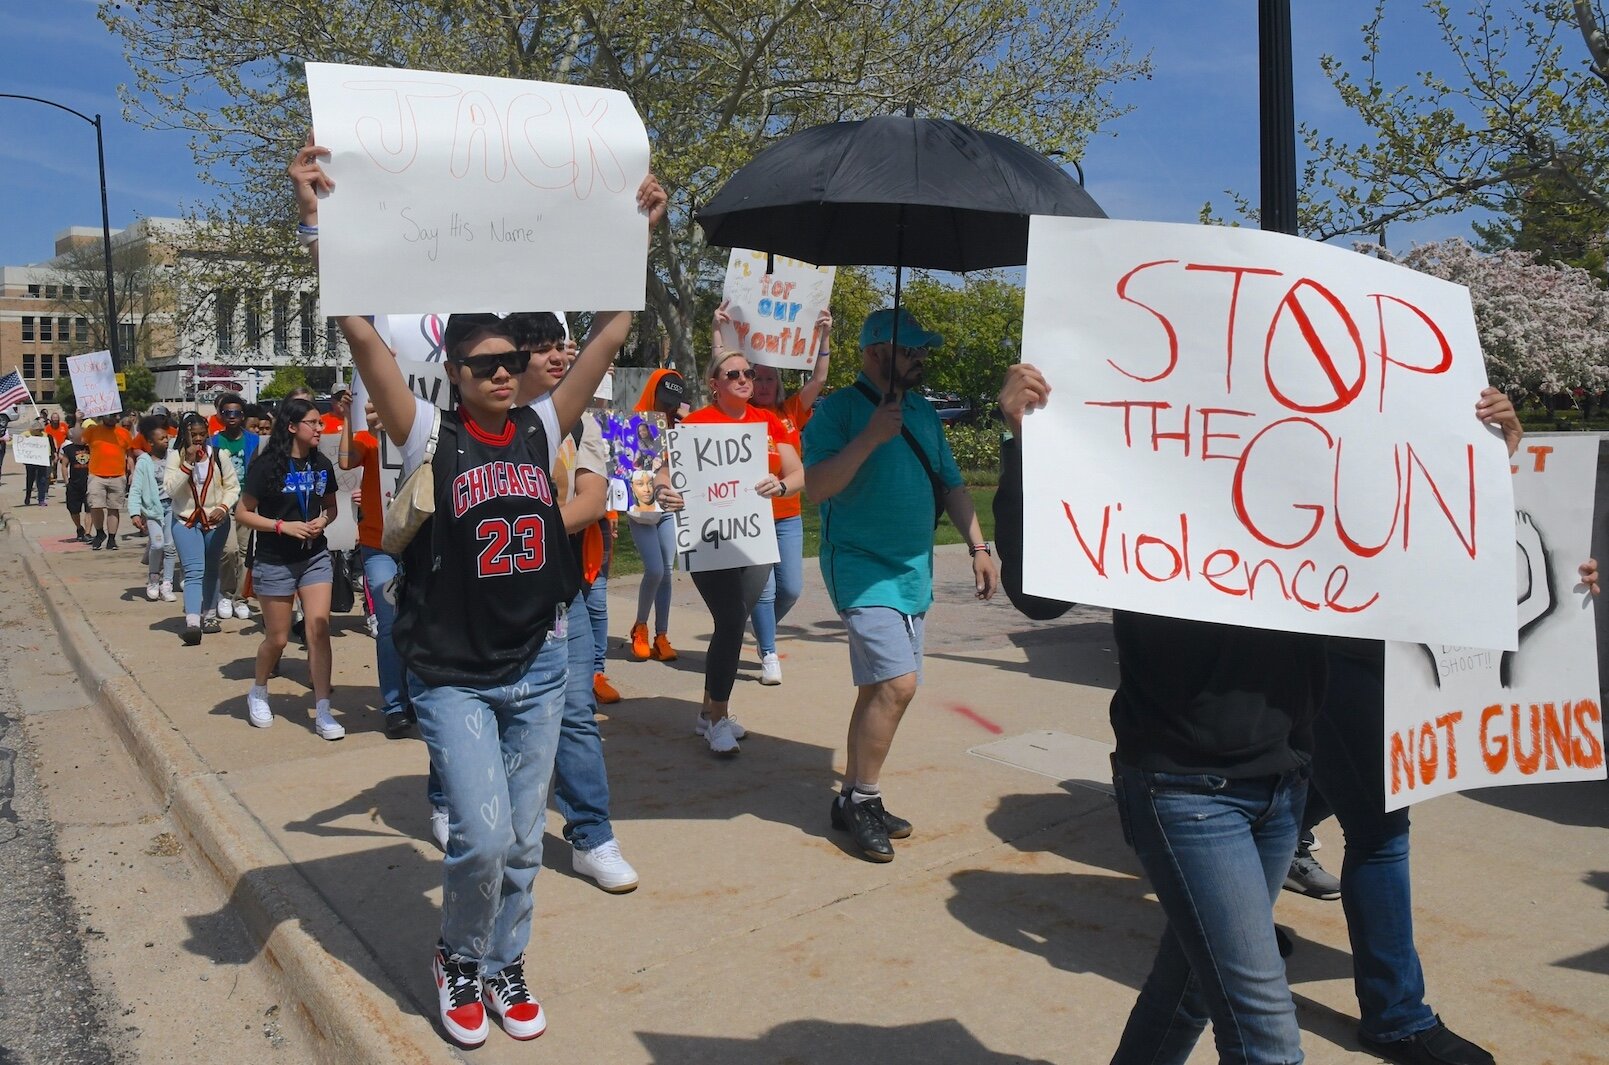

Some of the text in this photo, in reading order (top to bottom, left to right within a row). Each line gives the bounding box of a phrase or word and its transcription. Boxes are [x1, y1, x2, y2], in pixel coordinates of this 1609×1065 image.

[342, 80, 627, 201] JACK
[449, 212, 475, 243] His
[759, 273, 797, 300] for
[757, 297, 803, 323] our
[733, 319, 821, 364] Youth!
[1106, 258, 1453, 415] STOP
[693, 433, 753, 472] KIDS
[452, 460, 553, 519] CHICAGO
[707, 479, 740, 502] NOT
[1084, 399, 1478, 561] THE GUN
[475, 513, 547, 579] 23
[700, 512, 761, 550] GUNS
[1060, 498, 1380, 613] Violence
[1440, 652, 1492, 678] SHOOT!!
[1389, 697, 1604, 796] NOT GUNS
